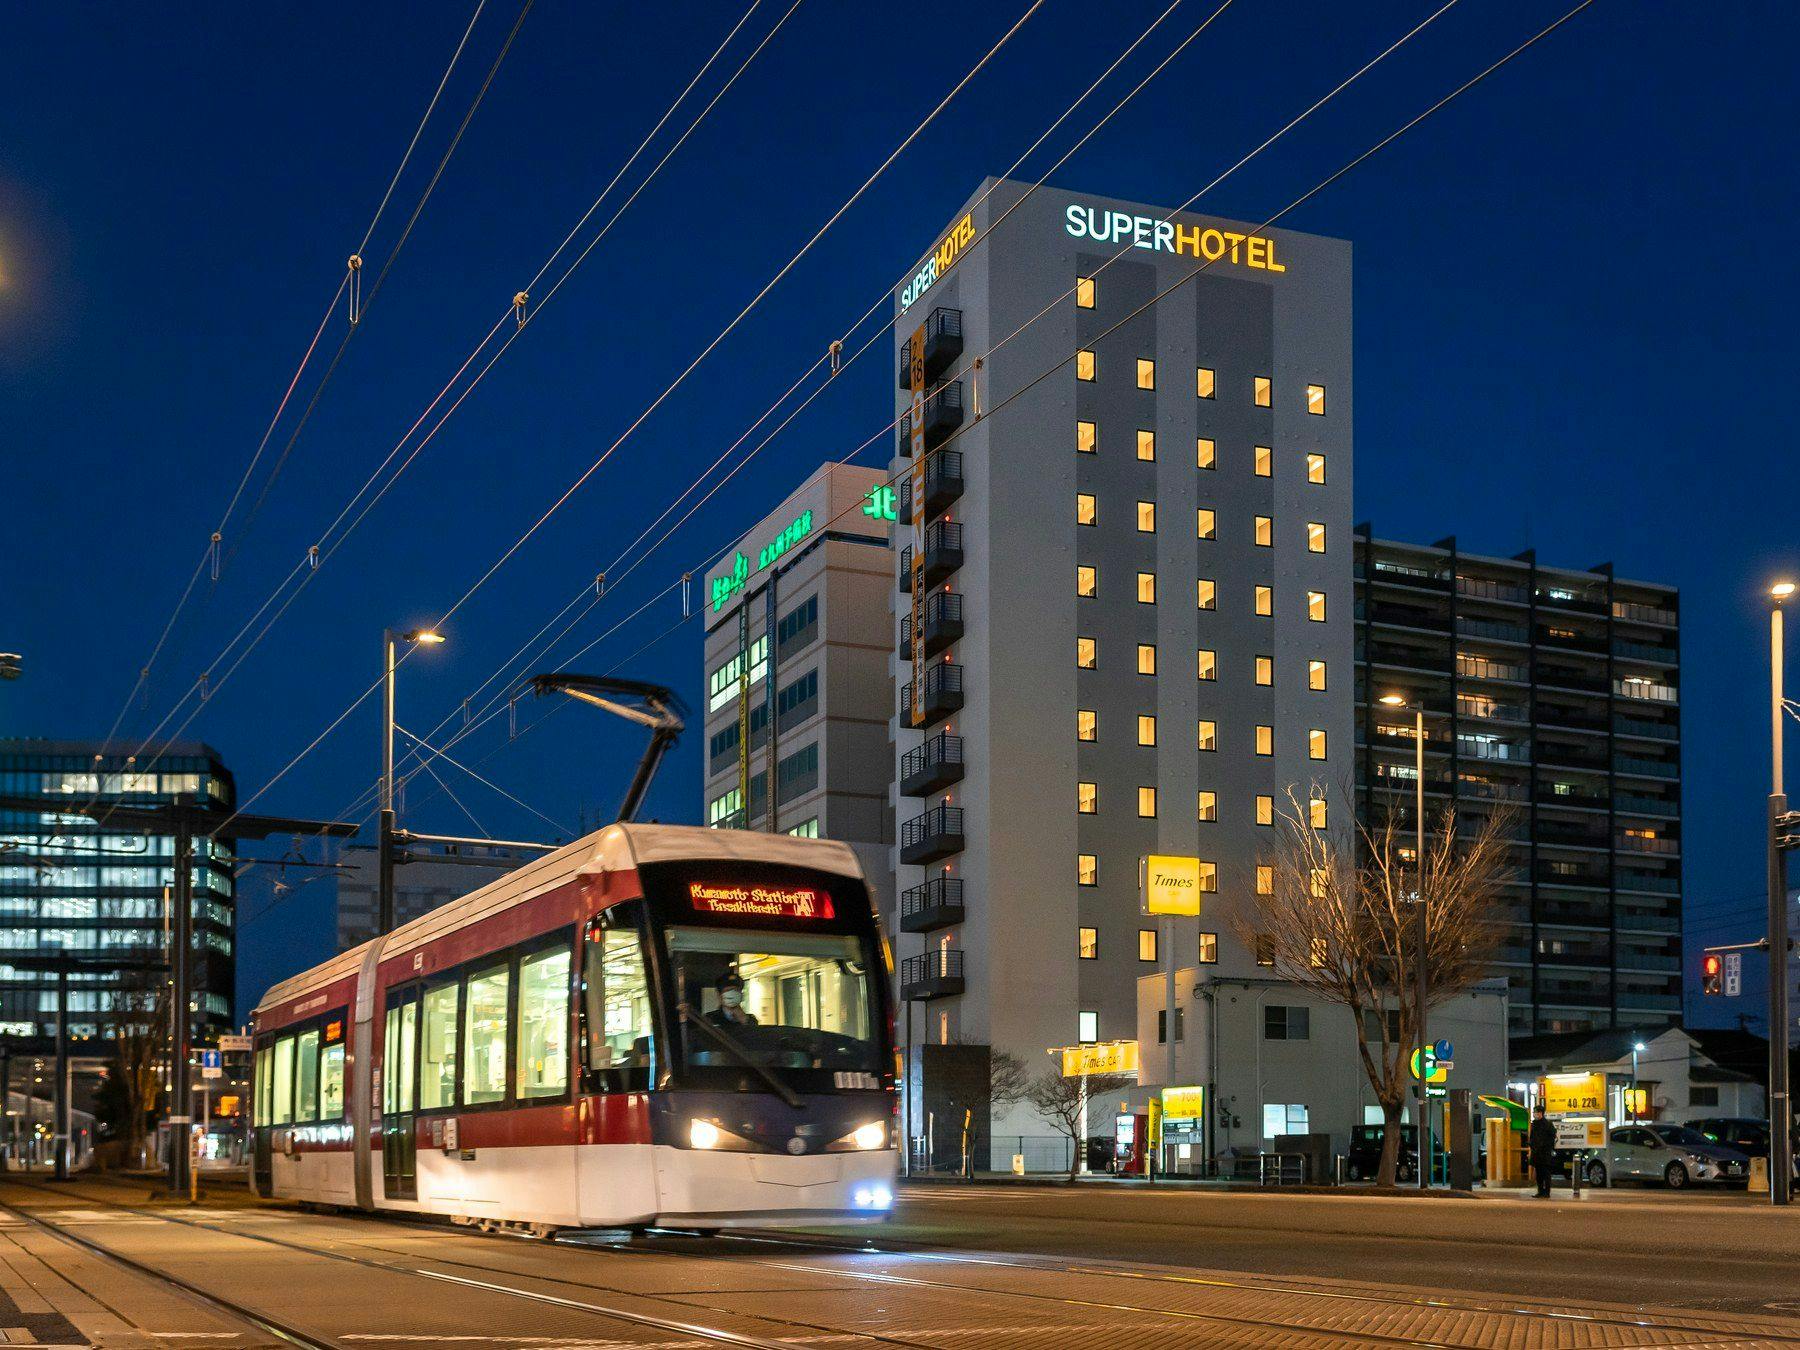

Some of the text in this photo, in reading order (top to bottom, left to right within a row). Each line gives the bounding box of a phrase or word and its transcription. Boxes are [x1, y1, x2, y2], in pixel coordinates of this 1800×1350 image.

[862, 484, 898, 521] 北
[1154, 874, 1194, 888] Times
[690, 884, 797, 904] Kumamoto Station
[1083, 1055, 1106, 1069] Times
